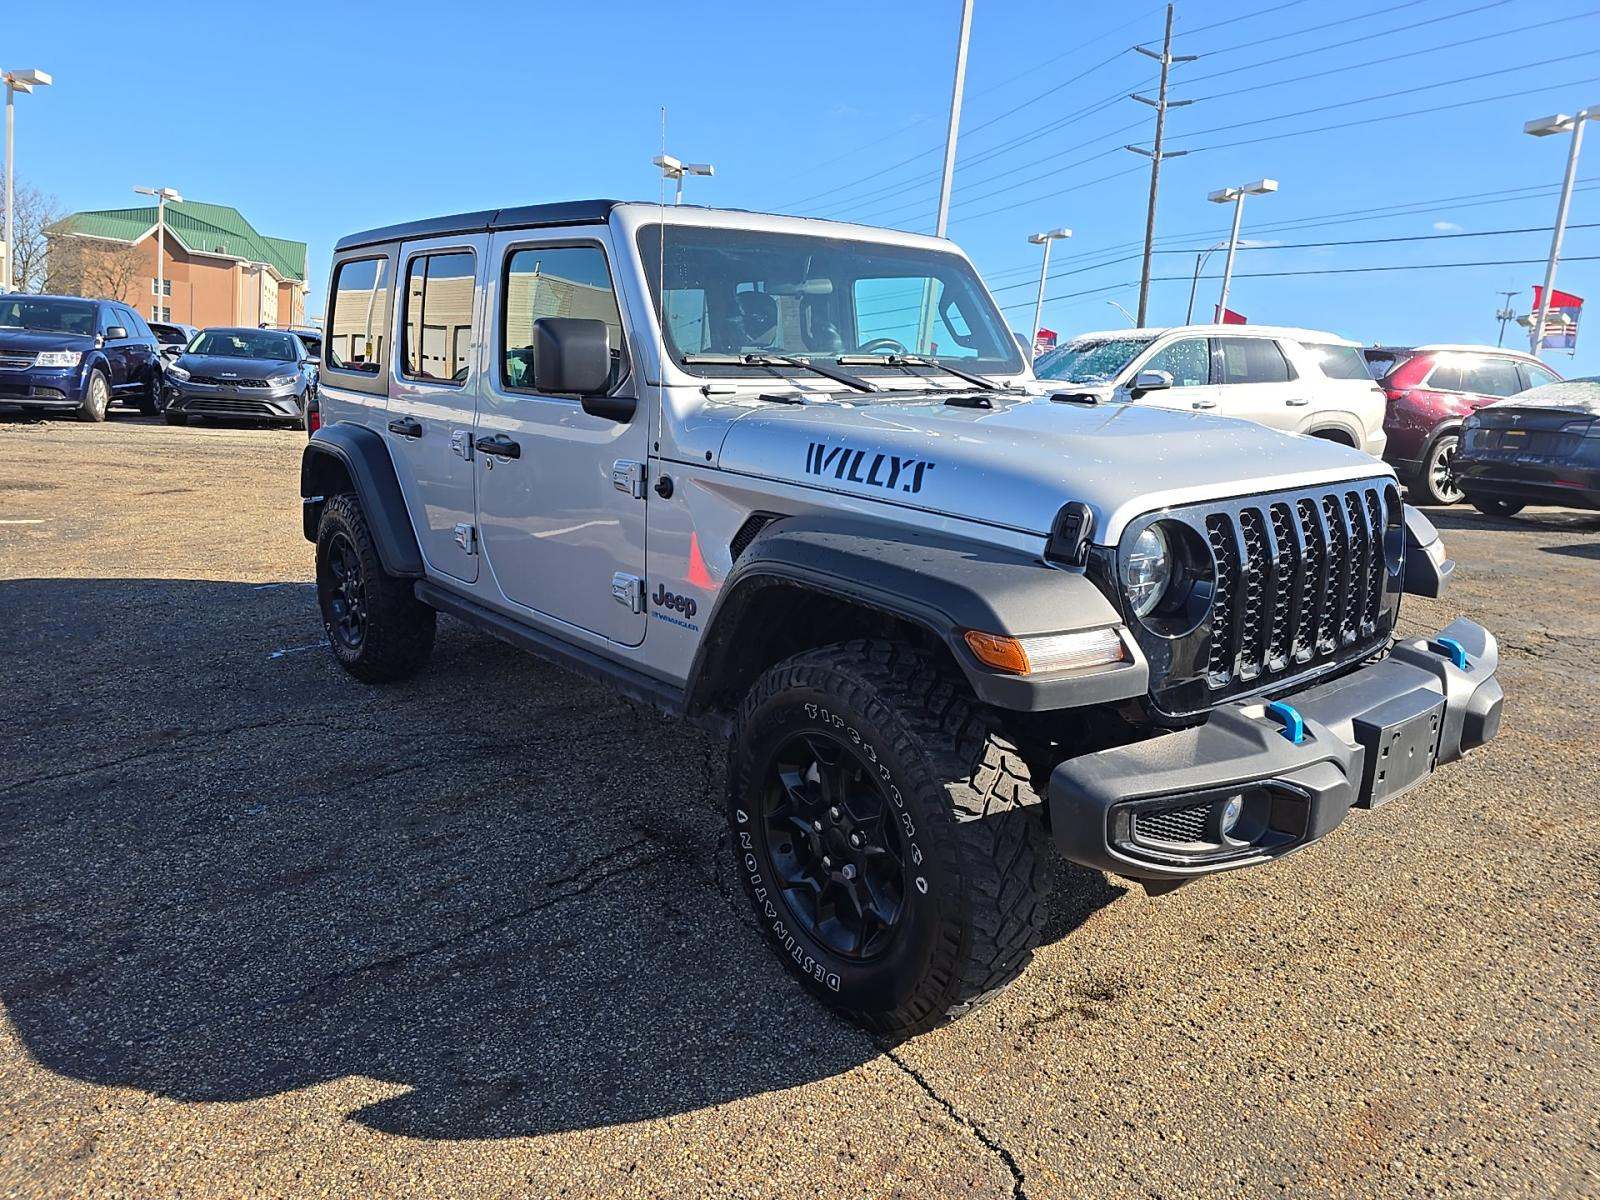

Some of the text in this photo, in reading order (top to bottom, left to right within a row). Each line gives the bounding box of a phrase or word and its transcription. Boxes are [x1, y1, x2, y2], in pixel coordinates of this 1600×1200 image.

[805, 442, 936, 493] WILLYS
[652, 583, 697, 619] Jeep
[739, 832, 841, 992] DESTINATION
